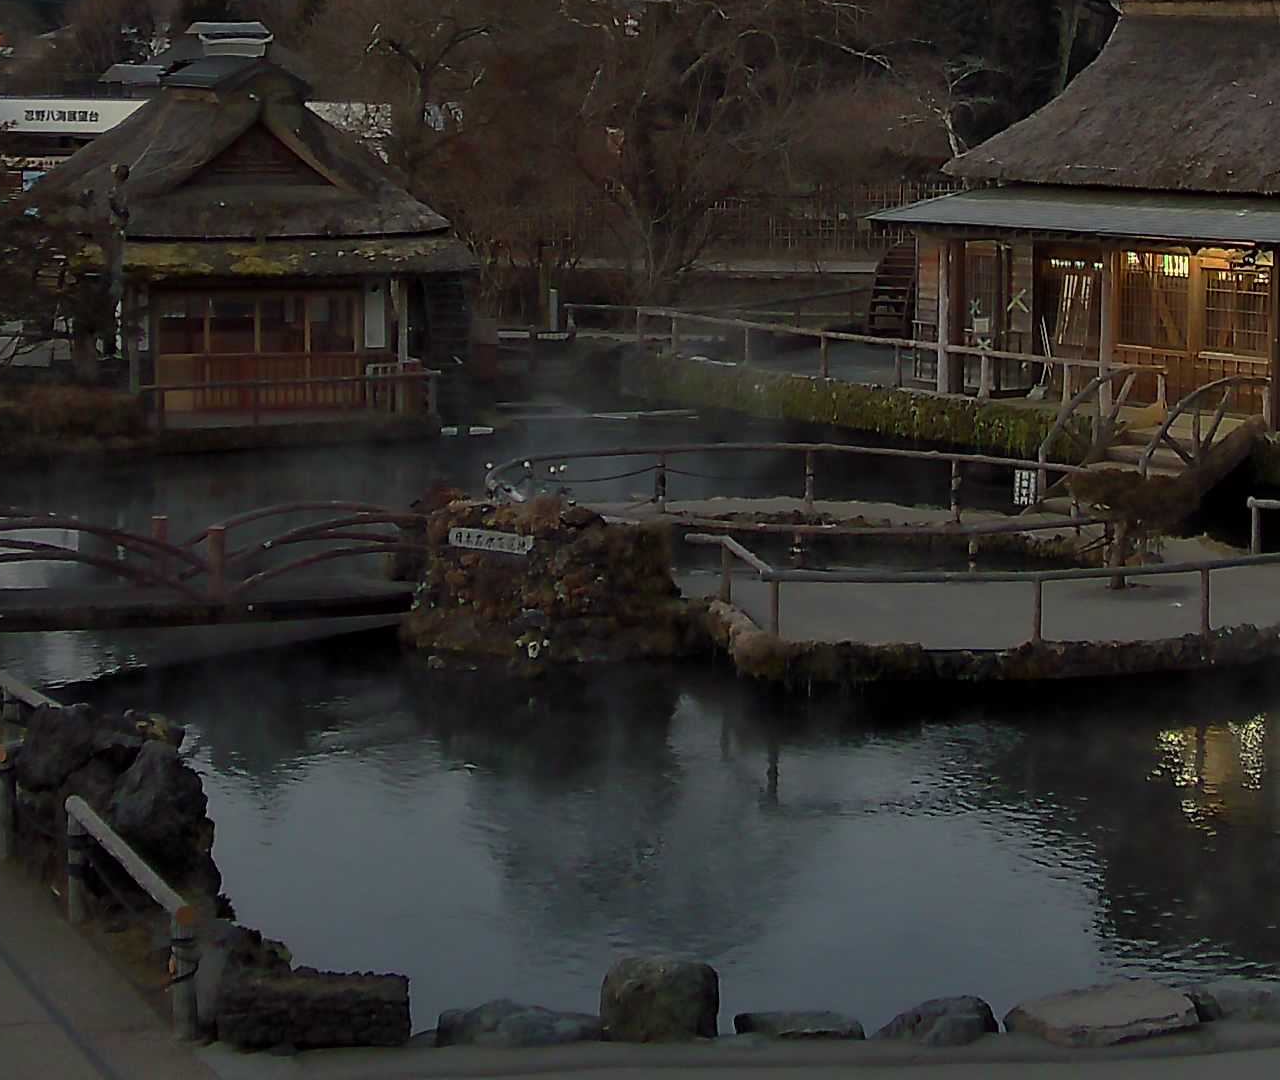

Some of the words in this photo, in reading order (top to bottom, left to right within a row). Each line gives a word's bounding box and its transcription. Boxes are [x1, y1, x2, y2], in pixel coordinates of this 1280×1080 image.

[24, 109, 100, 123] 忍野八海展望台
